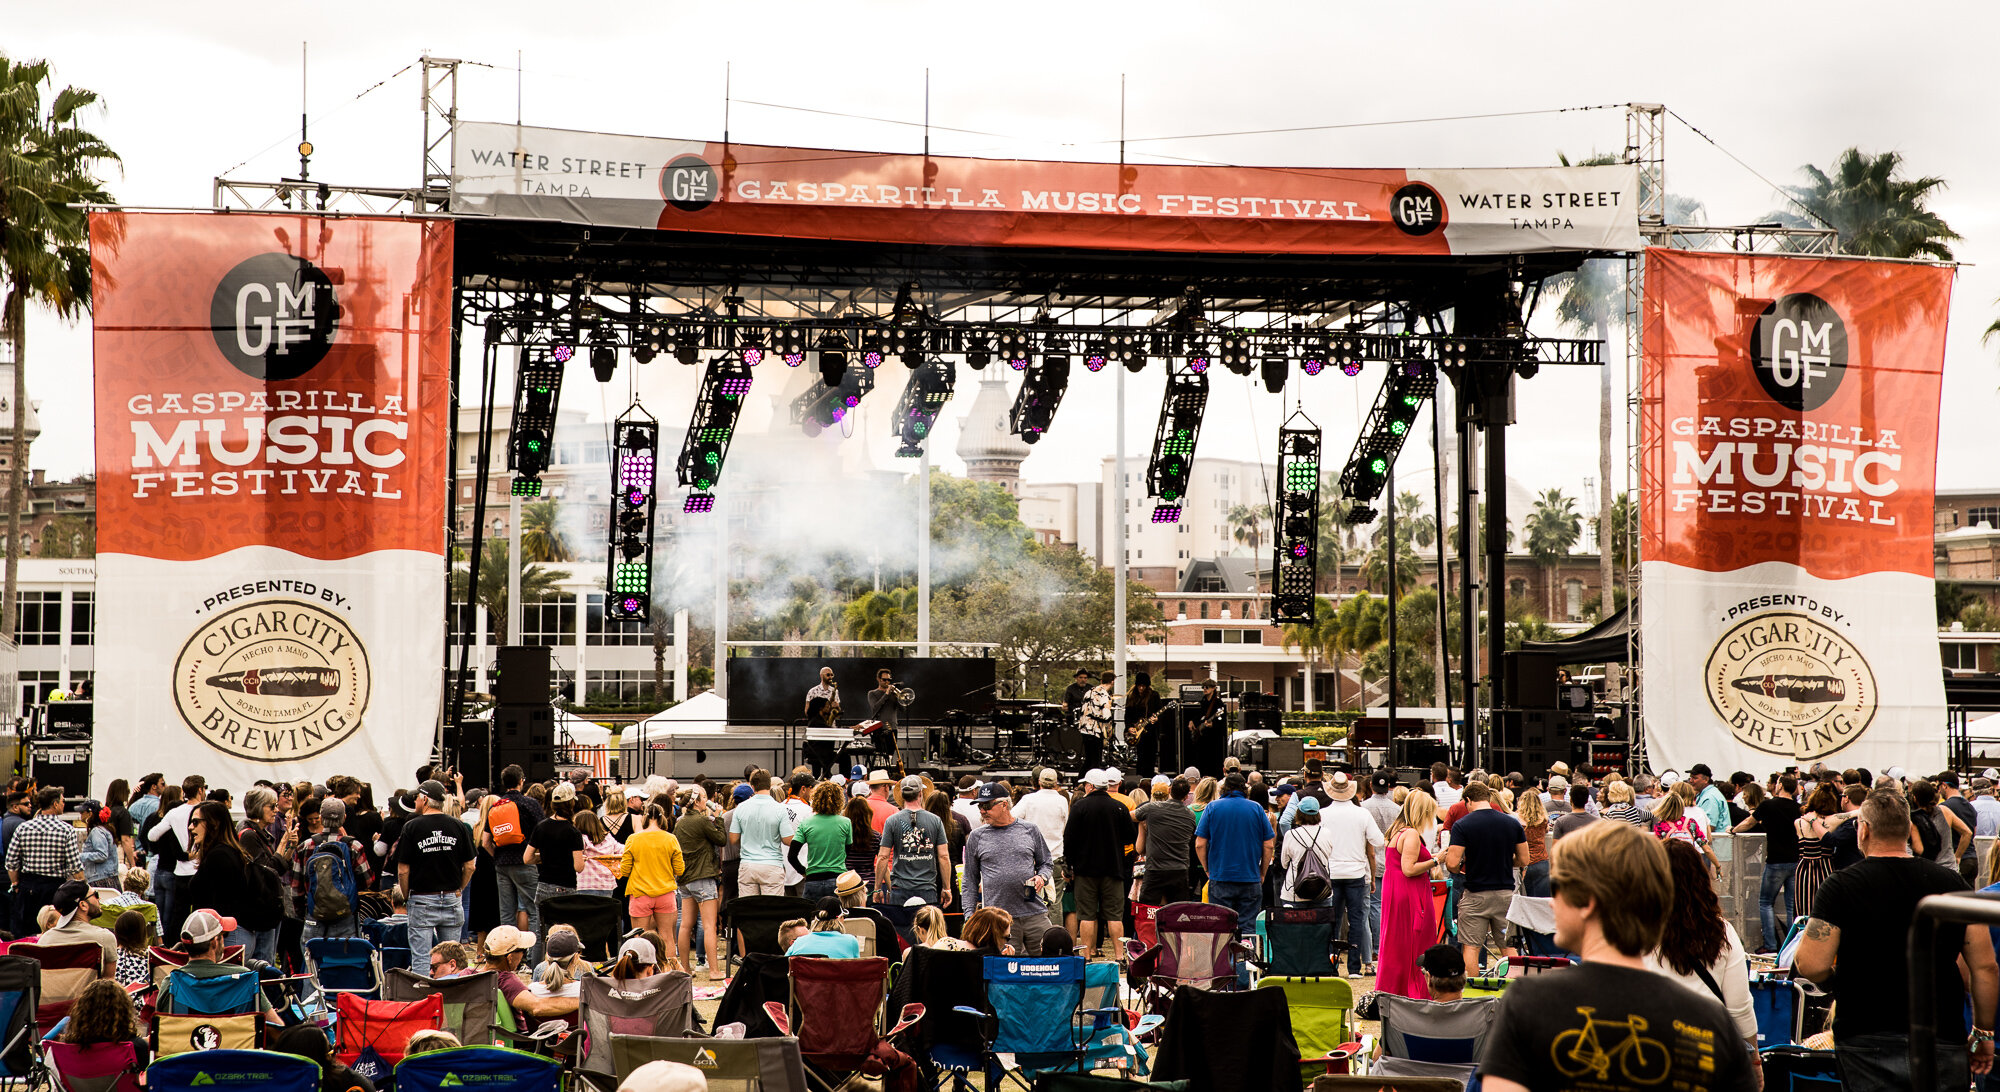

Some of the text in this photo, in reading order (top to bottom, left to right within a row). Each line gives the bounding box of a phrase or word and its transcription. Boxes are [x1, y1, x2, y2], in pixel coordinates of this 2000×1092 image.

[470, 149, 647, 180] WATER STREET
[524, 179, 592, 199] TAMPA
[737, 181, 1371, 221] GASPARILLA MUSIC FESTIVAL
[1459, 191, 1621, 209] WATER STREET
[1510, 217, 1574, 230] TAMPA
[127, 390, 408, 417] GASPARILLA
[130, 416, 408, 469] MUSIC
[1671, 416, 1901, 450] GASPARILLA
[1672, 440, 1902, 497] MUSIC
[131, 469, 402, 499] FESTIVAL
[1672, 489, 1896, 525] FESTIVAL
[204, 580, 346, 611] PRESENTED BY
[1821, 605, 1844, 622] BY
[203, 611, 350, 657] CIGAR CITY
[1727, 622, 1800, 661] CIGAR
[242, 645, 274, 662] HECHO
[236, 699, 261, 715] BORN
[201, 707, 347, 752] BREWING
[417, 835, 457, 850] RACONTEURS
[1020, 964, 1060, 972] UDDEHOLM
[247, 1072, 273, 1080] TRAIL
[494, 1074, 518, 1082] TRAIL
